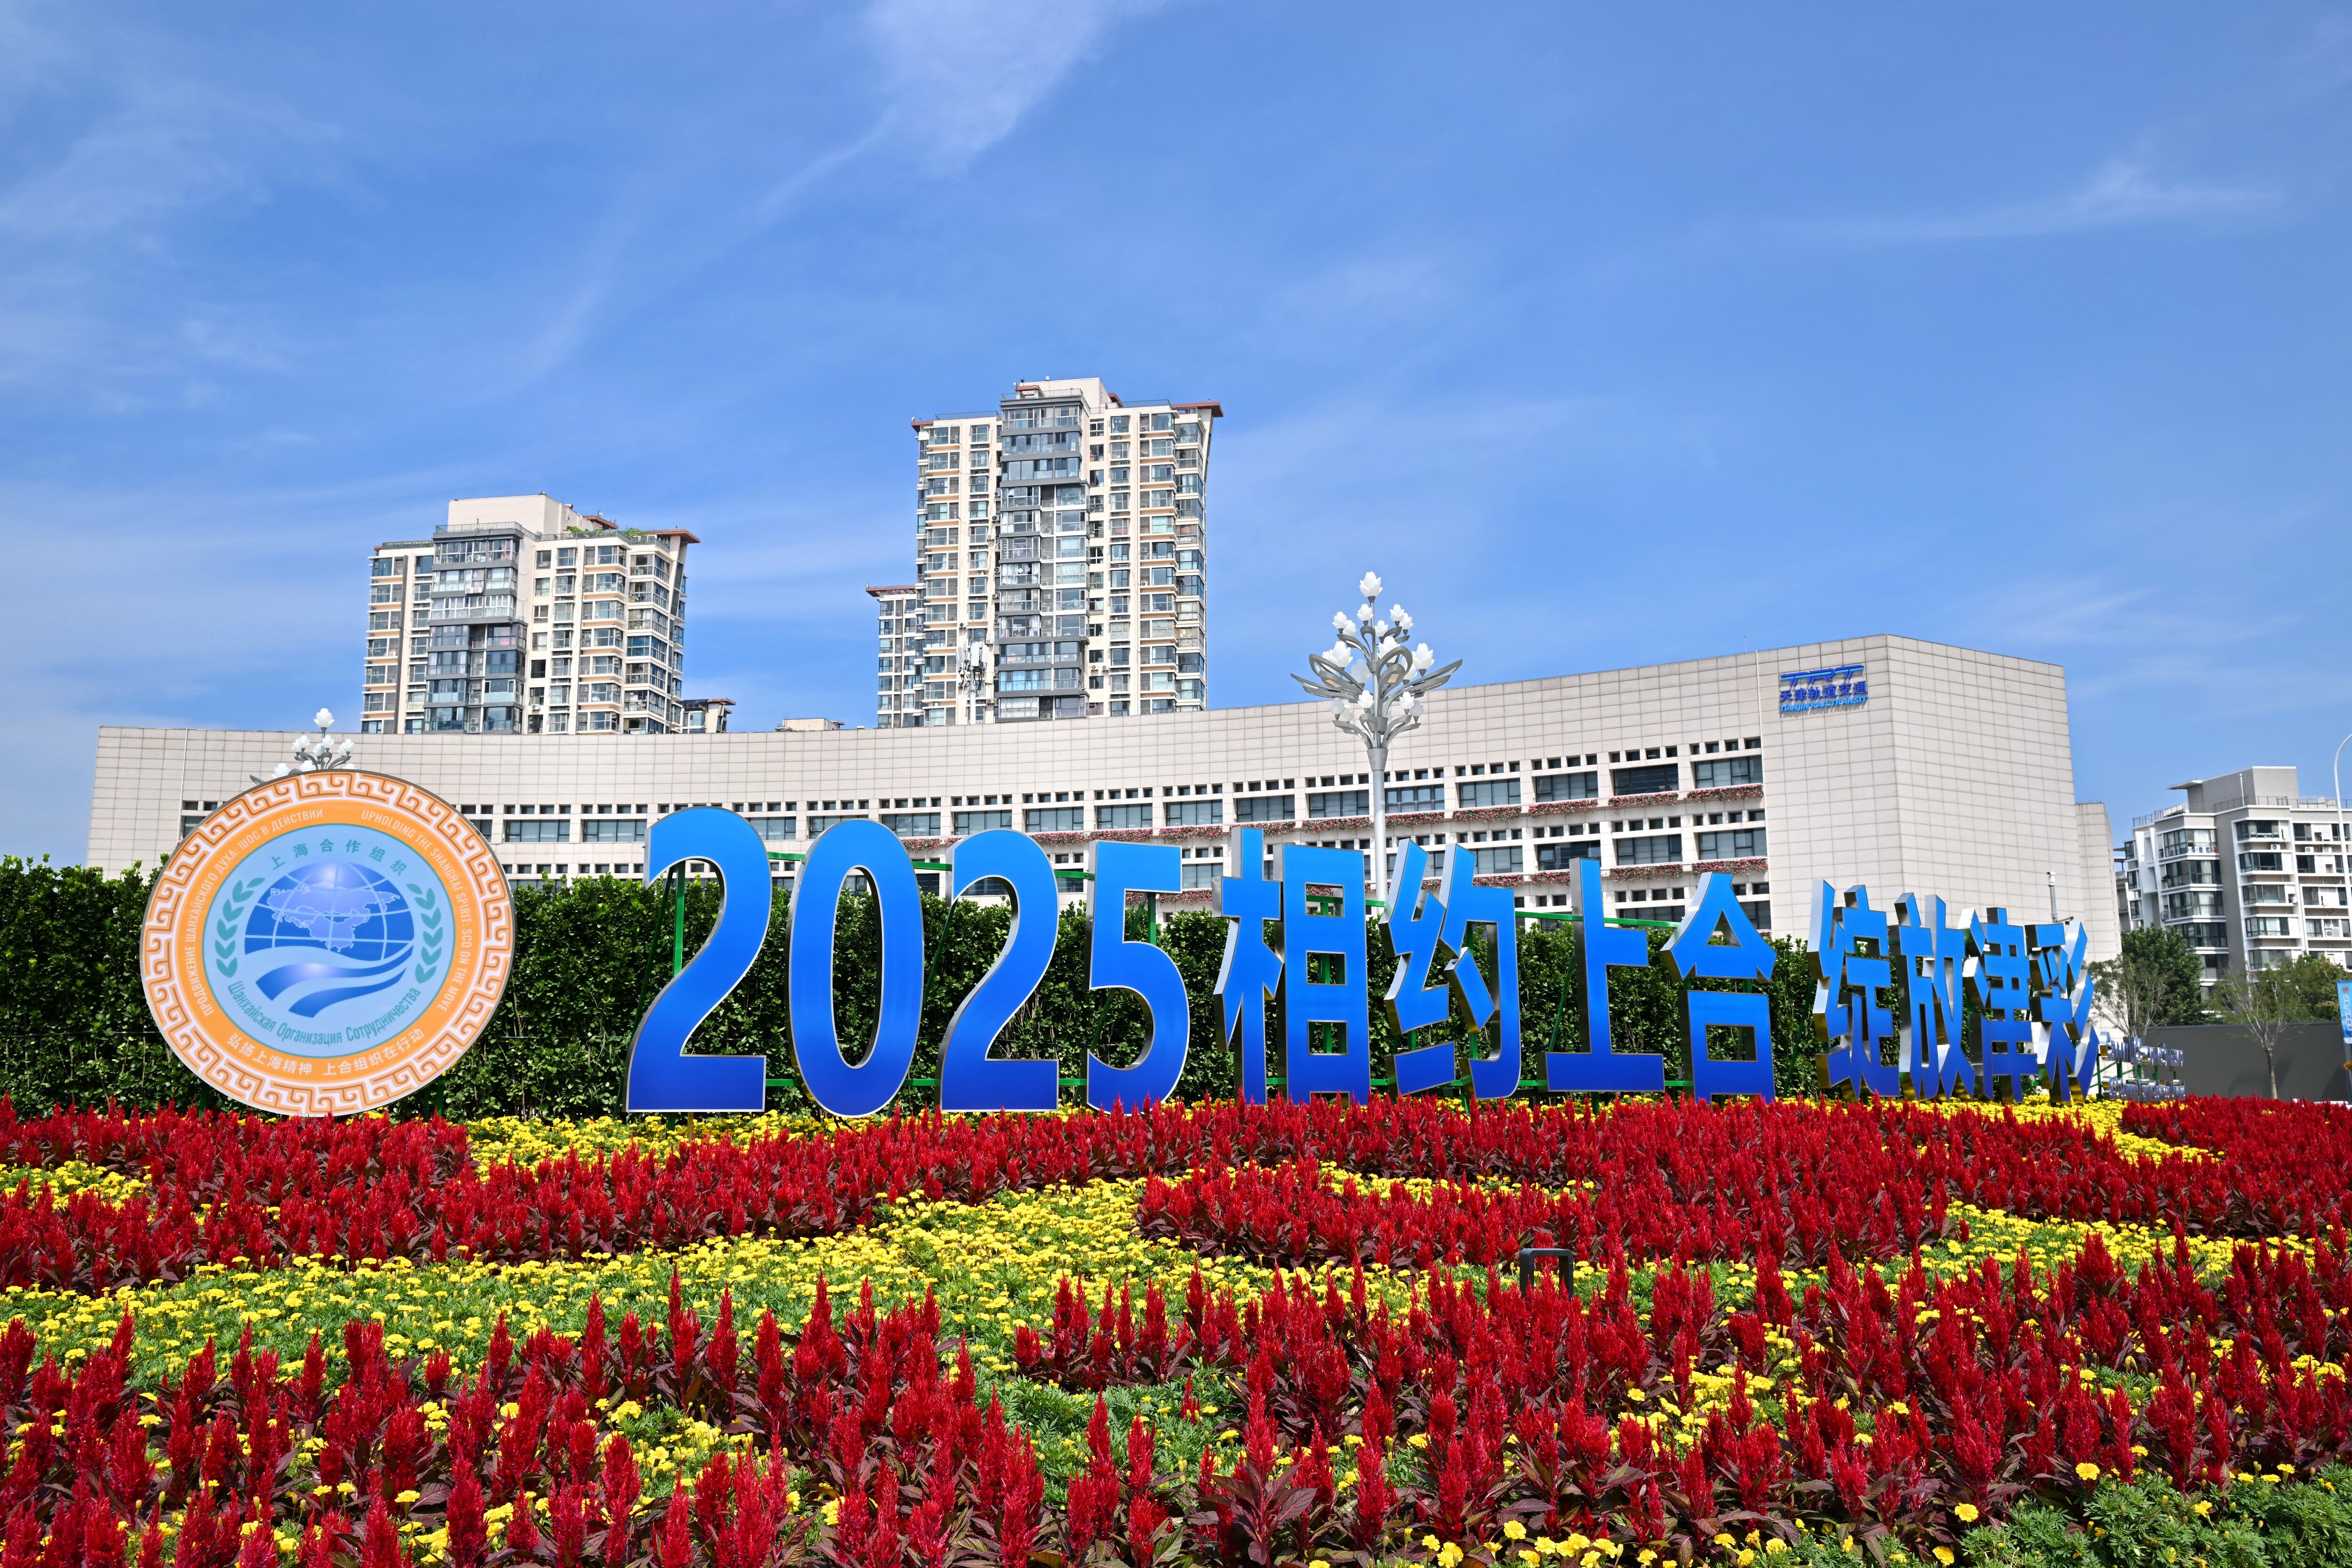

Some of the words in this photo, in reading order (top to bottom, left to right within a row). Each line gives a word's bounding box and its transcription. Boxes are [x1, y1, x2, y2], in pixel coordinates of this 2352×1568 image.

[1780, 664, 1864, 686] TRT
[1780, 681, 1868, 703] 天津轨道交通
[1780, 704, 1811, 712] TIANJIN
[1811, 700, 1830, 708] RAIL
[1830, 696, 1868, 705] TRANSIT
[262, 826, 270, 836] В
[271, 809, 324, 832] ДЕЙСТВИИ
[362, 810, 416, 838] UPHOLDING
[237, 831, 261, 850] ШОС
[415, 834, 433, 851] THE
[214, 848, 239, 875] ДУХА:
[271, 838, 407, 876] 上海合作组织
[430, 848, 463, 891] SHANGHAI
[185, 873, 218, 942] ШАНХАЙСКОГО
[456, 892, 472, 926] SPIRIT:
[461, 929, 472, 947] SCO
[459, 950, 470, 964] ON
[185, 945, 215, 1017] ПРОДВИЖЕНИЕ
[452, 968, 467, 985] THE
[437, 986, 459, 1012] MOVE
[227, 980, 277, 1032] Шанхайская
[277, 1022, 342, 1046] Организация
[346, 987, 421, 1042] Сотрудничества
[227, 1033, 312, 1076] 弘扬上海精神
[323, 1027, 424, 1076] 上合组织在行动
